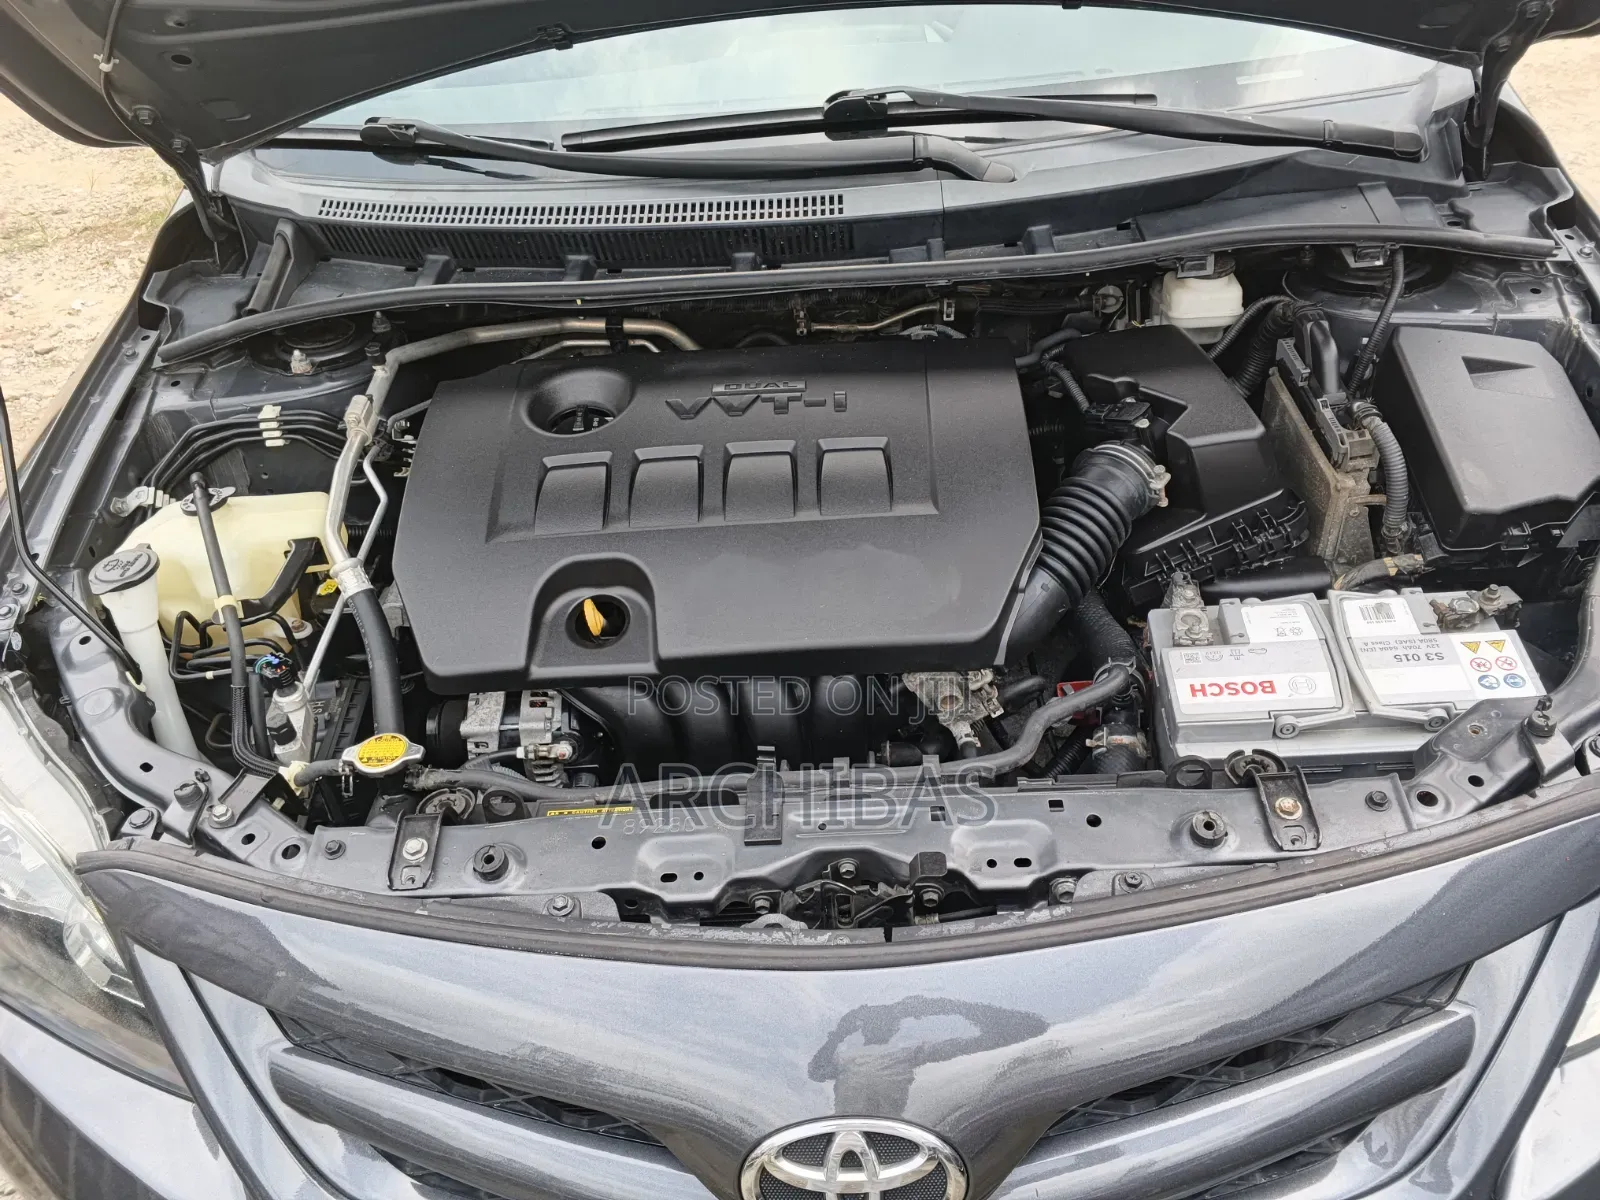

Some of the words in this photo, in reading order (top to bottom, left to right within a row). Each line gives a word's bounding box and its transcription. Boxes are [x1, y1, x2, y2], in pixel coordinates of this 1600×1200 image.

[723, 381, 798, 391] DUAL
[1393, 653, 1421, 663] 015
[1424, 652, 1445, 661] S3
[1189, 680, 1277, 698] BOSCH
